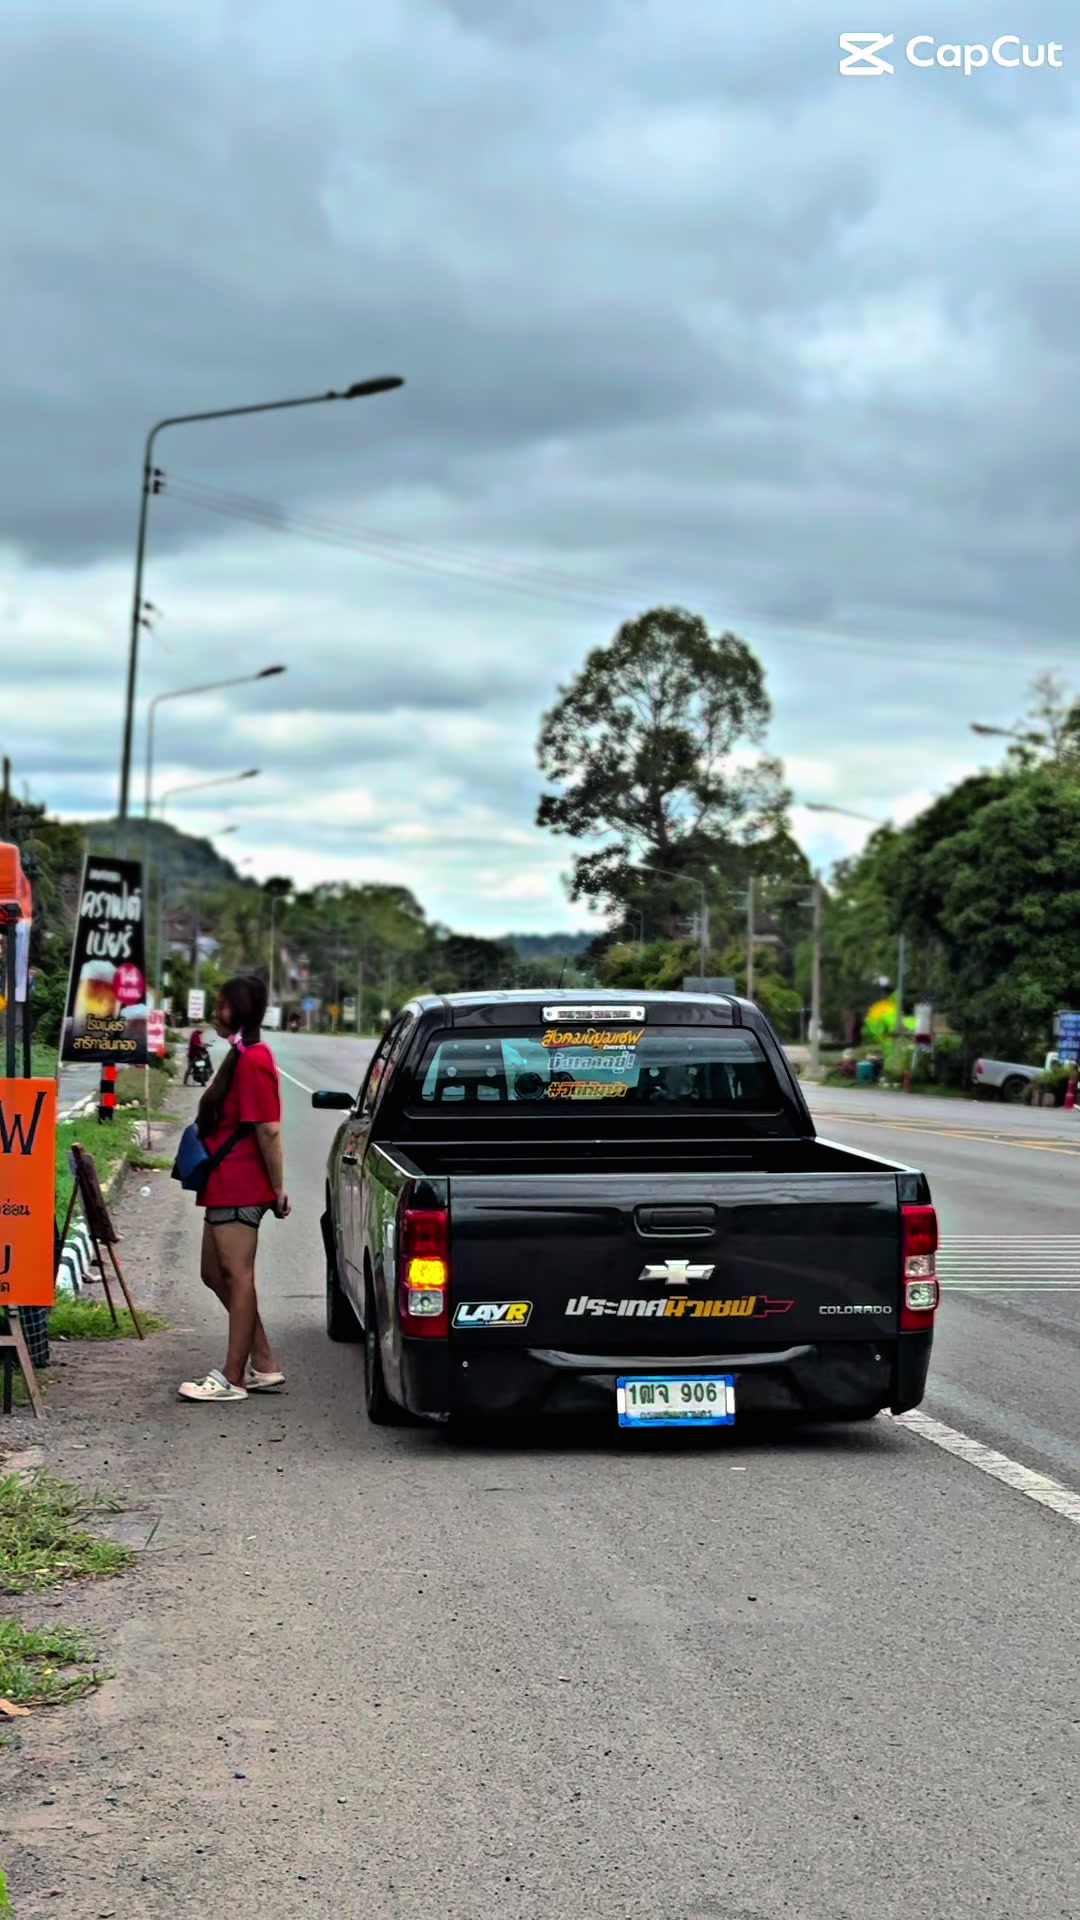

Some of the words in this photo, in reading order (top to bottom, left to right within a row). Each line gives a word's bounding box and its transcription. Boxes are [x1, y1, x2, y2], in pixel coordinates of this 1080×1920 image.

[86, 922, 133, 958] เบียร์
[456, 1303, 529, 1321] LAYR
[818, 1305, 893, 1315] COLORADO
[681, 1382, 717, 1403] 906
